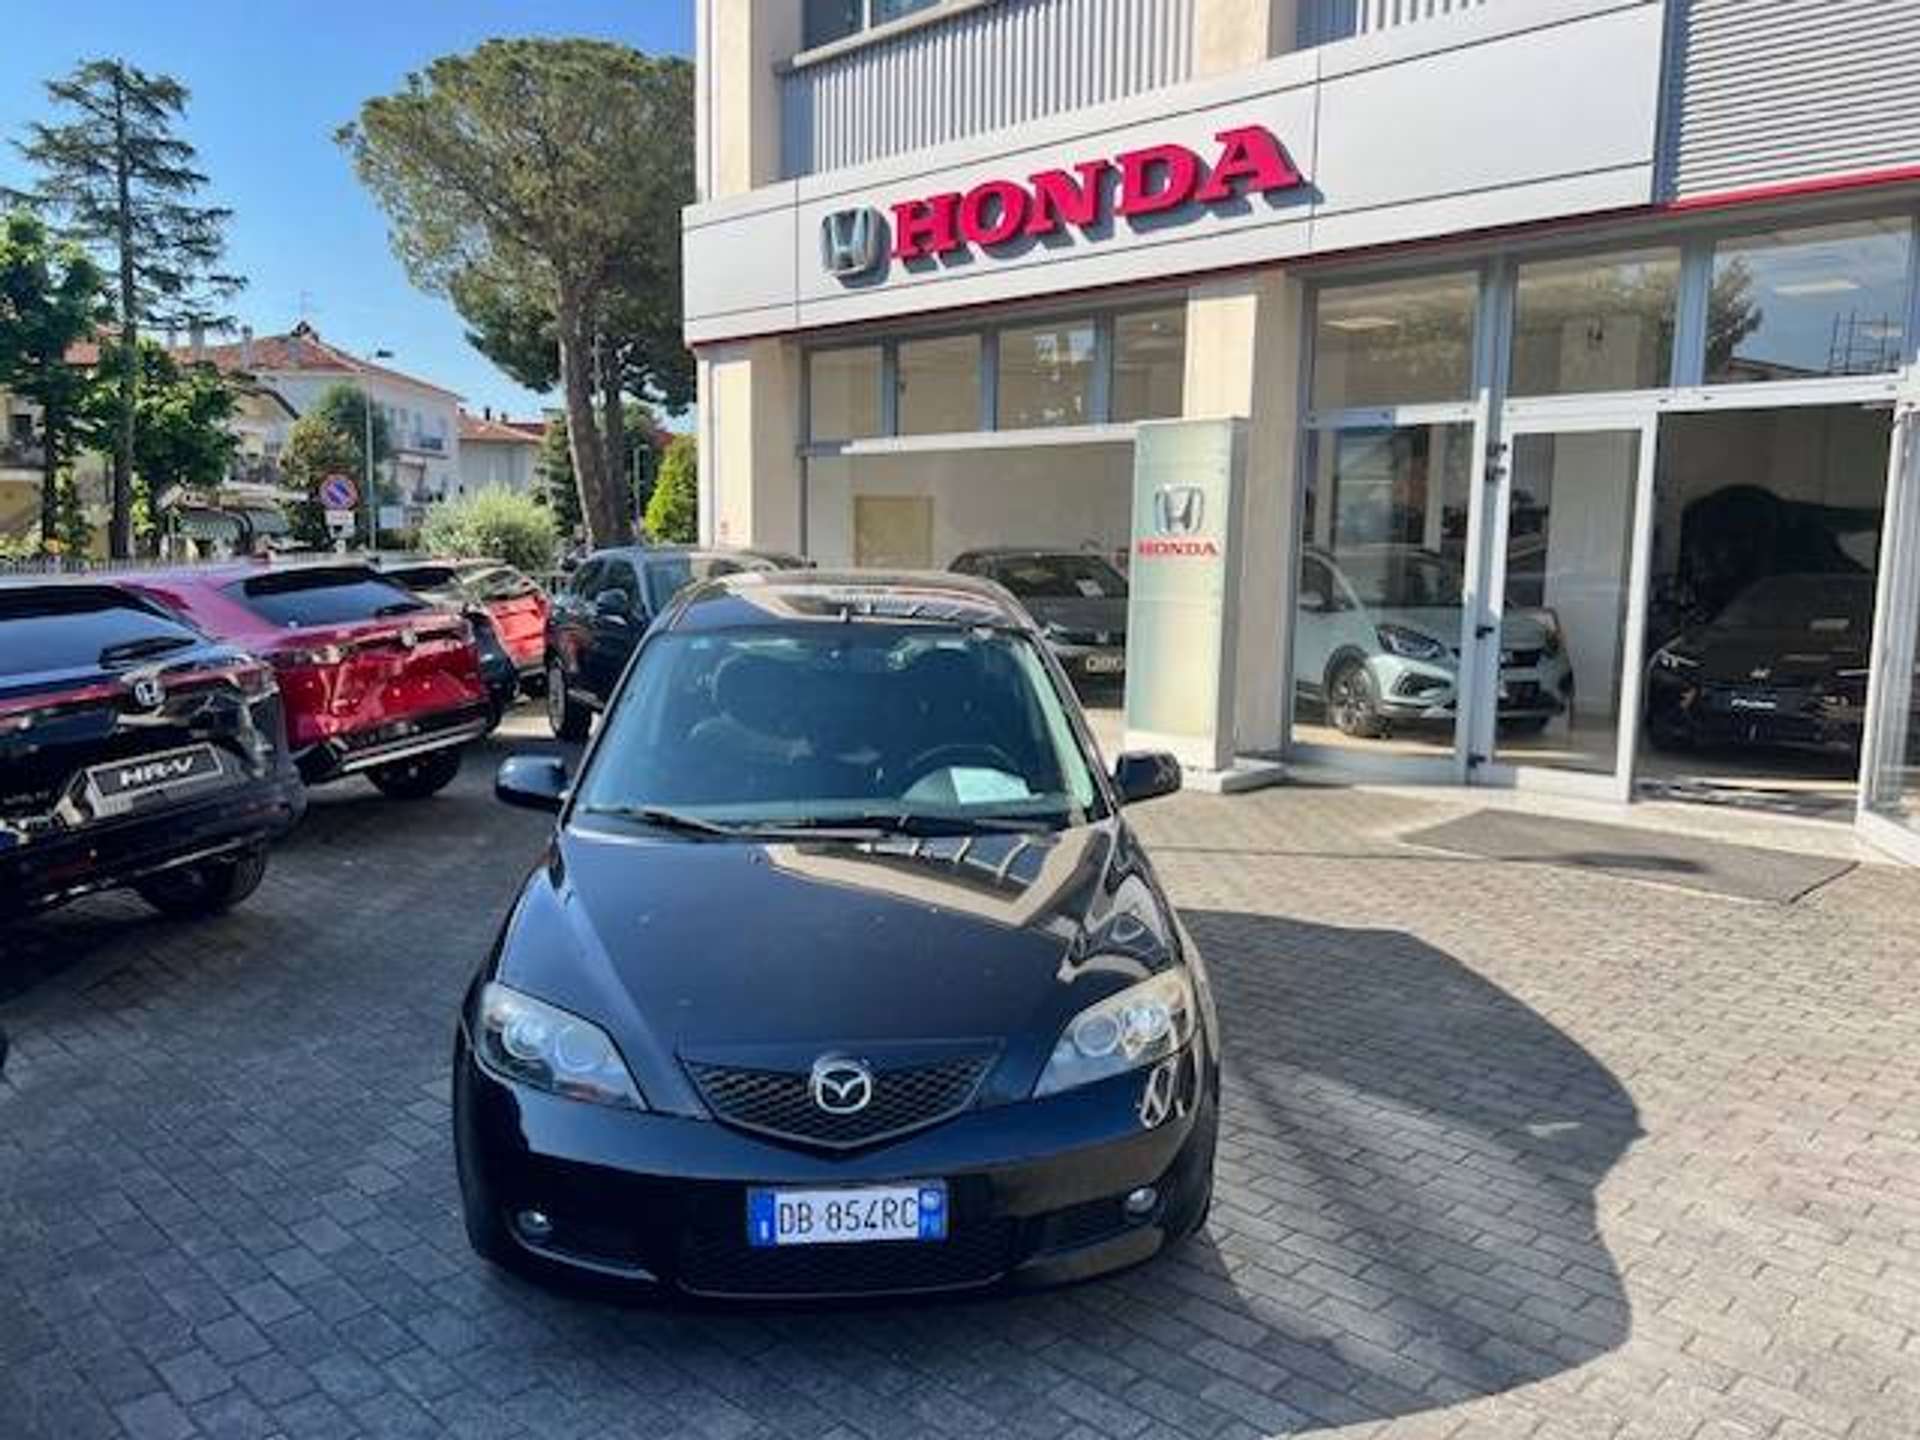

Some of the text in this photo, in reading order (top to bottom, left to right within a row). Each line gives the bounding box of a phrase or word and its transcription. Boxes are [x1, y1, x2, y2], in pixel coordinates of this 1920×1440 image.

[890, 124, 1300, 258] HONDA
[1137, 541, 1217, 556] HONDA
[121, 756, 193, 785] HR-V
[779, 1202, 813, 1234] DB
[825, 1197, 917, 1232] 854RC
